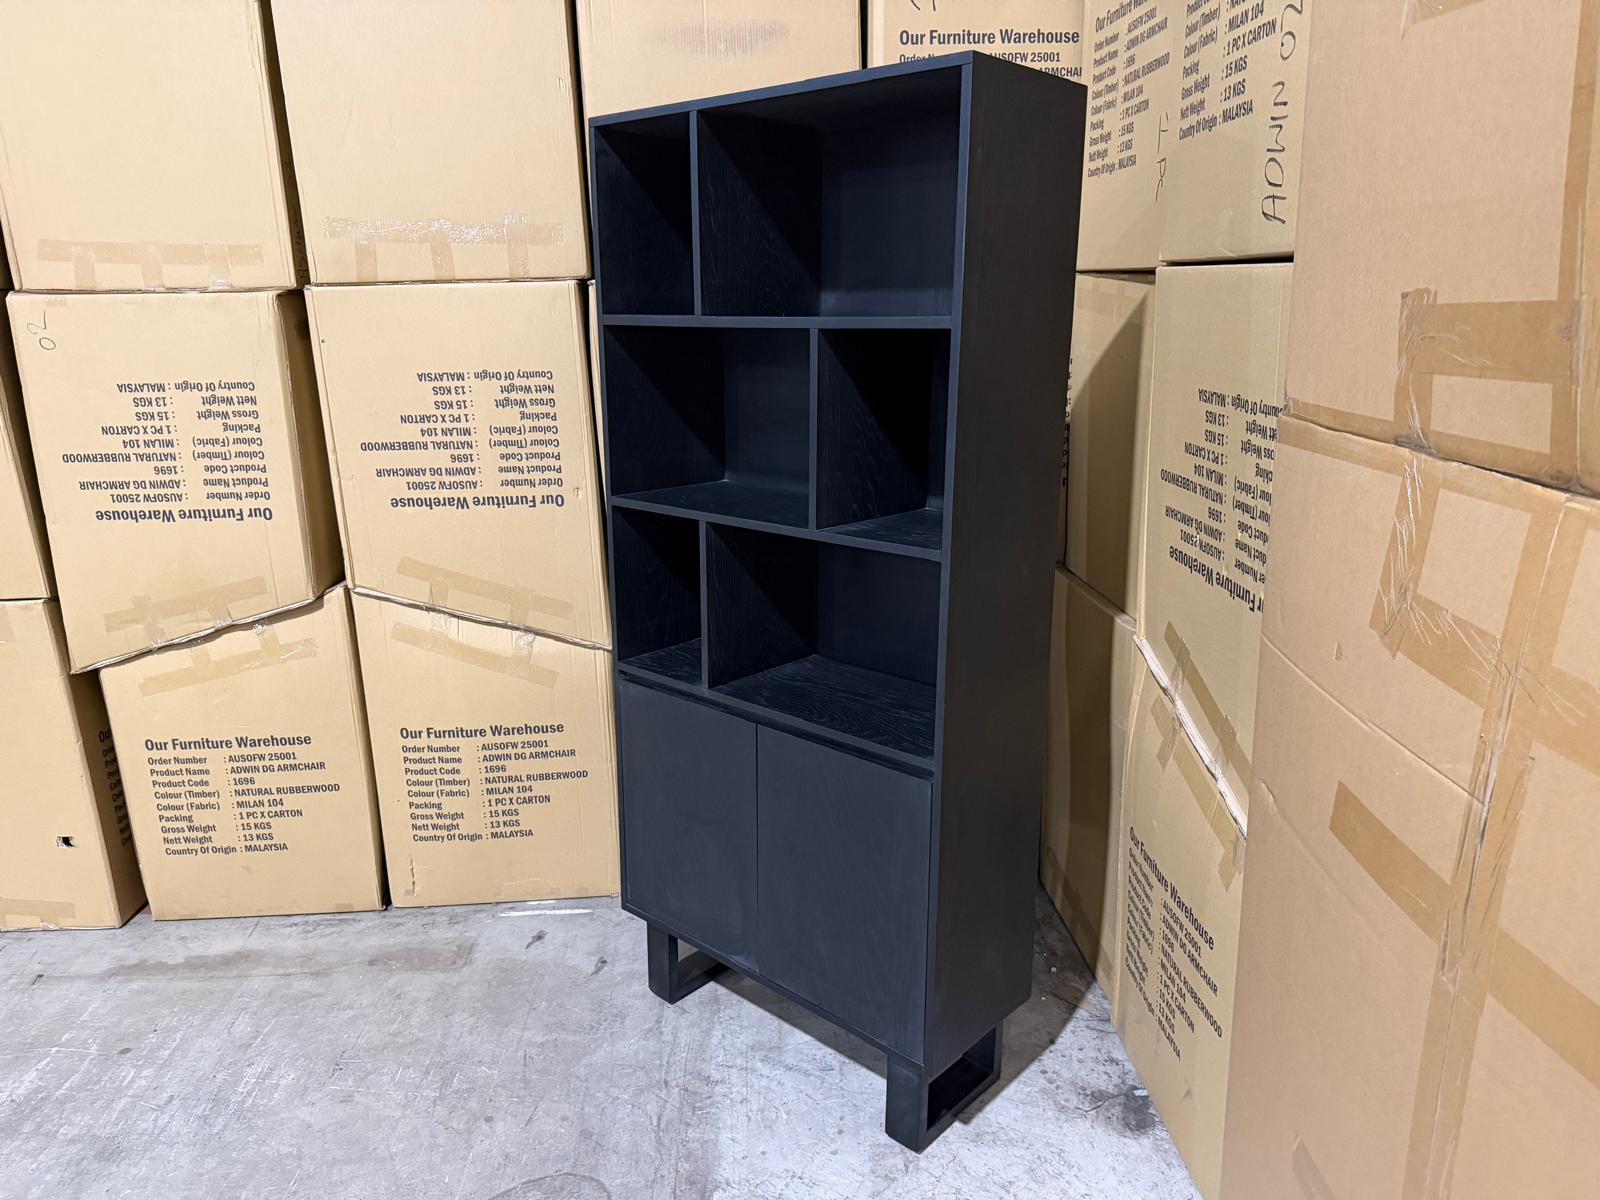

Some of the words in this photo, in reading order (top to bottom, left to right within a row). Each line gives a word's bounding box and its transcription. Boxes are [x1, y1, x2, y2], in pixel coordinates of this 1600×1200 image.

[1106, 0, 1133, 27] Furniture
[1185, 20, 1200, 39] Colour
[1199, 2, 1221, 32] (Timber)
[1183, 41, 1198, 59] Colour
[1197, 25, 1218, 54] (Fabric)
[1228, 7, 1250, 32] MILAN
[1250, 1, 1264, 22] 104
[1247, 17, 1277, 46] CARTON
[900, 30, 926, 46] Our
[929, 29, 996, 45] Furniture
[999, 28, 1080, 45] Warehouse
[1030, 52, 1060, 63] 25001
[1181, 85, 1194, 101] Gross
[1193, 73, 1210, 94] Weight
[1224, 61, 1233, 79] 15
[1233, 54, 1248, 75] KGS
[1179, 105, 1190, 121] Nett
[1189, 96, 1206, 117] Weight
[1223, 84, 1232, 102] 13
[1232, 78, 1246, 98] KGS
[1178, 123, 1195, 141] Country
[1195, 118, 1202, 134] Of
[1201, 113, 1218, 133] Origin
[1221, 98, 1253, 124] MALAYSIA
[132, 397, 153, 408] KGS
[154, 396, 167, 407] 13
[200, 393, 236, 407] Weight
[235, 395, 257, 406] Nett
[433, 400, 454, 410] KGS
[455, 399, 468, 410] 15
[494, 396, 528, 409] Weight
[529, 398, 556, 408] Gross
[101, 425, 140, 436] CARTON
[141, 425, 149, 435] X
[150, 425, 164, 435] PC
[165, 425, 172, 435] 1
[222, 422, 261, 434] Packing
[420, 427, 439, 437] 104
[440, 427, 472, 437] MILAN
[489, 424, 527, 436] (Fabric)
[528, 425, 559, 435] Colour
[62, 452, 132, 463] RUBBERWOOD
[132, 452, 177, 462] NATURAL
[192, 449, 232, 461] (Timber)
[233, 450, 265, 460] Colour
[450, 453, 474, 463] 1696
[499, 452, 523, 462] Code
[524, 451, 561, 461] Product
[375, 467, 427, 478] ARMCHAIR
[428, 467, 443, 477] DG
[444, 466, 477, 476] ADWIN
[498, 465, 525, 475] Name
[526, 464, 562, 475] Product
[1194, 463, 1205, 478] 104
[203, 478, 230, 488] Name
[231, 477, 269, 488] Product
[500, 478, 536, 489] Number
[537, 477, 564, 488] Order
[1160, 468, 1198, 495] RUBBERWOOD
[1205, 467, 1224, 487] MILAN
[78, 480, 131, 491] ARMCHAIR
[132, 480, 147, 490] DG
[148, 479, 181, 490] ADWIN
[406, 481, 437, 491] 25001
[438, 480, 478, 490] AUSOFW
[109, 493, 141, 504] 25001
[143, 493, 183, 503] AUSOFW
[206, 492, 243, 502] Number
[244, 491, 271, 501] Order
[540, 494, 565, 507] Our
[1198, 483, 1224, 506] NATURAL
[390, 496, 470, 510] Warehouse
[472, 495, 537, 509] Furniture
[1232, 495, 1258, 521] (Timber)
[95, 509, 176, 523] Warehouse
[178, 508, 244, 522] Furniture
[247, 507, 273, 521] Our
[1165, 505, 1194, 528] ARMCHAIR
[1207, 506, 1222, 524] 1696
[1194, 518, 1203, 535] DG
[1203, 522, 1223, 543] ADWIN
[1237, 520, 1253, 539] Code
[1169, 545, 1214, 587] Warehouse
[1215, 571, 1256, 613] Furniture
[400, 727, 423, 739] Our
[426, 726, 487, 739] Furniture
[489, 723, 564, 737] Warehouse
[144, 739, 169, 751] Our
[171, 737, 233, 750] Furniture
[234, 735, 312, 748] Warehouse
[401, 745, 426, 754] Order
[426, 744, 461, 753] Number
[481, 741, 519, 752] AUSOFW
[520, 739, 549, 749] 25001
[147, 757, 172, 766] Order
[173, 756, 207, 765] Number
[228, 753, 266, 763] AUSOFW
[267, 751, 297, 761] 25001
[403, 756, 437, 765] Product
[437, 756, 463, 764] Name
[482, 753, 512, 763] ADWIN
[513, 752, 527, 761] DG
[528, 748, 576, 760] ARMCHAIR
[149, 768, 184, 777] Product
[185, 767, 210, 776] Name
[230, 765, 260, 774] ADWIN
[262, 764, 276, 773] DG
[277, 761, 326, 772] ARMCHAIR
[151, 779, 187, 788] Product
[187, 778, 210, 787] Code
[232, 776, 256, 786] 1696
[405, 778, 434, 787] Colour
[435, 777, 471, 788] (Timber)
[484, 774, 525, 785] NATURAL
[526, 770, 589, 782] RUBBERWOOD
[154, 791, 183, 800] Colour
[184, 789, 220, 801] (Timber)
[234, 787, 275, 797] NATURAL
[275, 783, 340, 795] RUBBERWOOD
[407, 789, 435, 798] Colour
[436, 788, 470, 799] (Fabric)
[486, 786, 514, 796] MILAN
[516, 784, 533, 794] 104
[156, 803, 185, 812] Colour
[186, 801, 221, 812] (Fabric)
[236, 799, 265, 809] MILAN
[267, 798, 284, 808] 104
[408, 801, 443, 811] Packing
[487, 798, 493, 807] 1
[494, 797, 507, 807] PC
[508, 797, 515, 806] X
[515, 794, 551, 805] CARTON
[412, 834, 445, 843] Country
[446, 833, 456, 841] Of
[457, 832, 483, 842] Origin
[490, 829, 534, 839] MALAYSIA
[1129, 826, 1140, 850] Our
[1140, 840, 1169, 893] Furniture
[1170, 882, 1214, 951] Warehouse
[1161, 943, 1183, 983] NATURAL
[1182, 976, 1223, 1038] RUBBERWOOD
[1174, 996, 1195, 1033] CARTON
[1157, 1016, 1181, 1061] MALAYSIA
